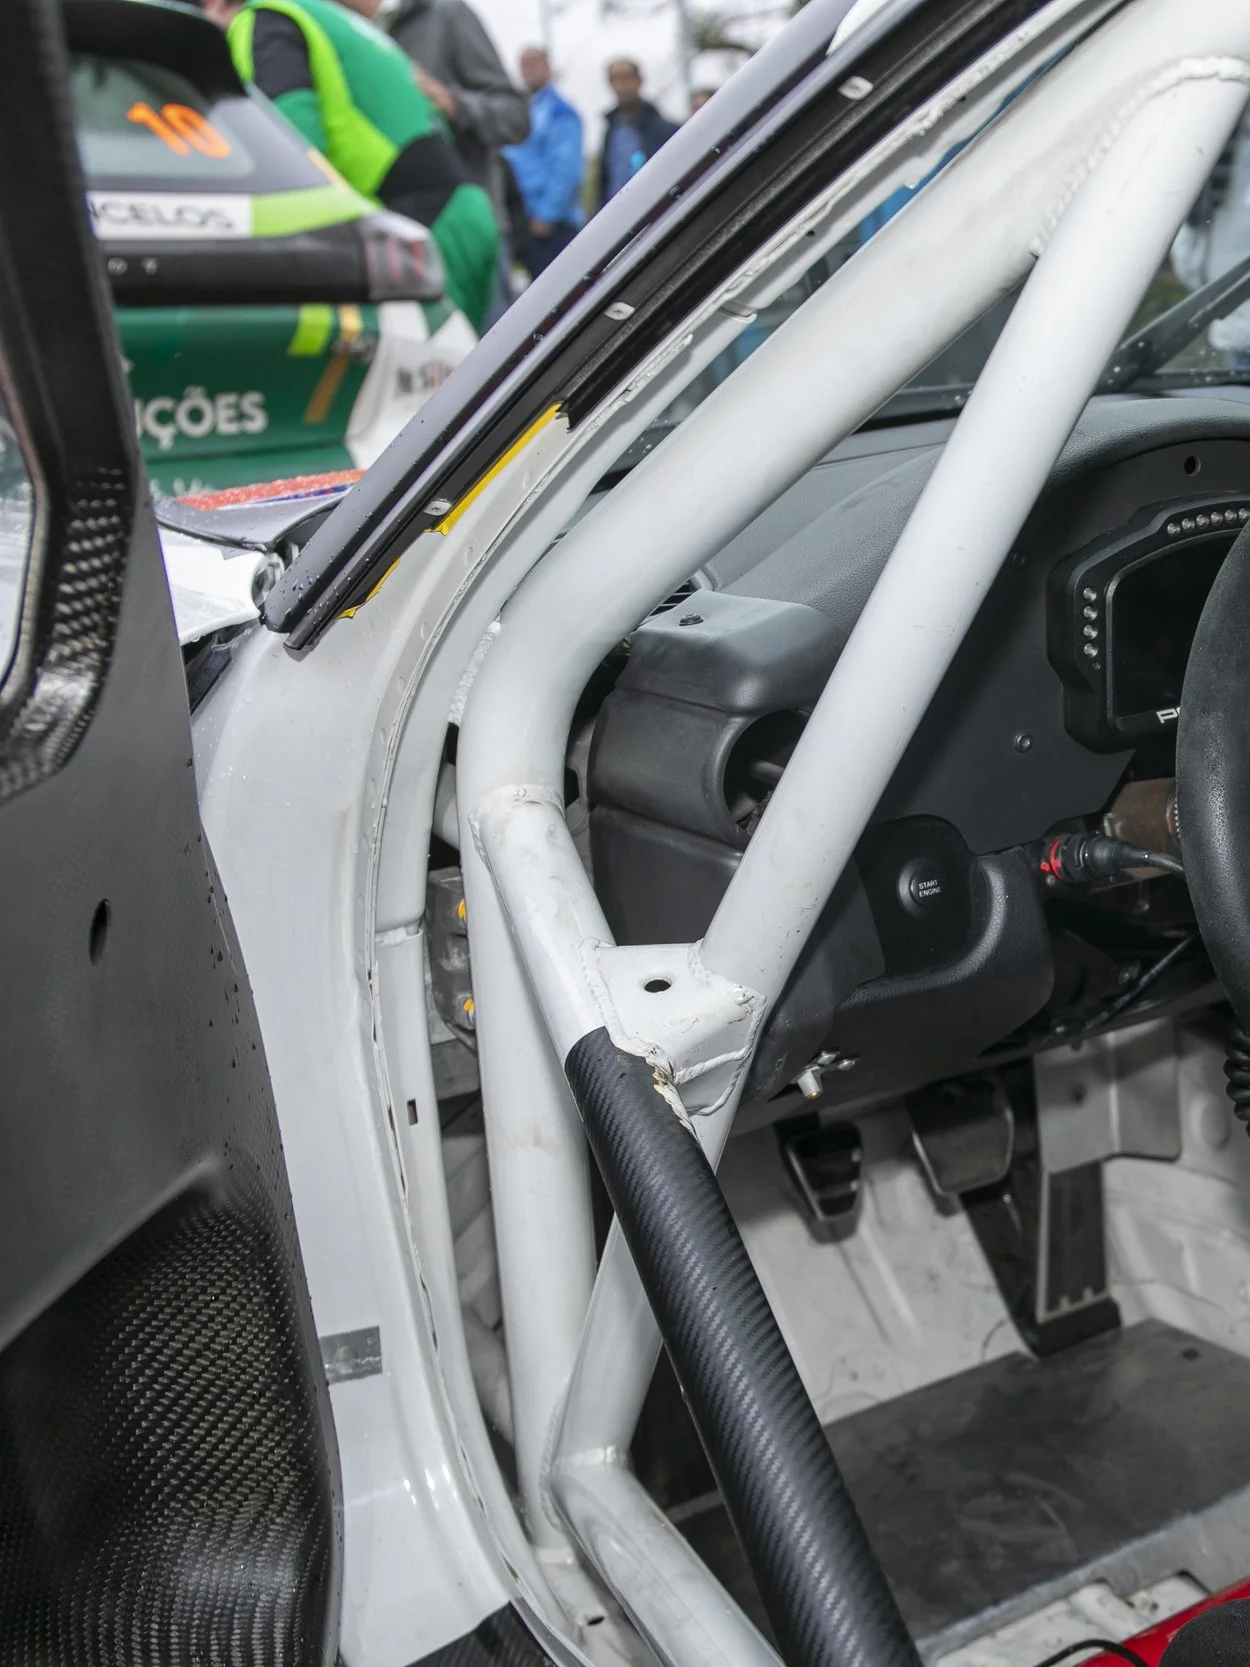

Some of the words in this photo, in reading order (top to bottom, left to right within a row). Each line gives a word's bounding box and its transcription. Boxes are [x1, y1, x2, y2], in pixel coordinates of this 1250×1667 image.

[125, 101, 232, 158] 10
[1156, 706, 1180, 724] P
[919, 880, 938, 889] START
[919, 887, 942, 897] ENGINE
